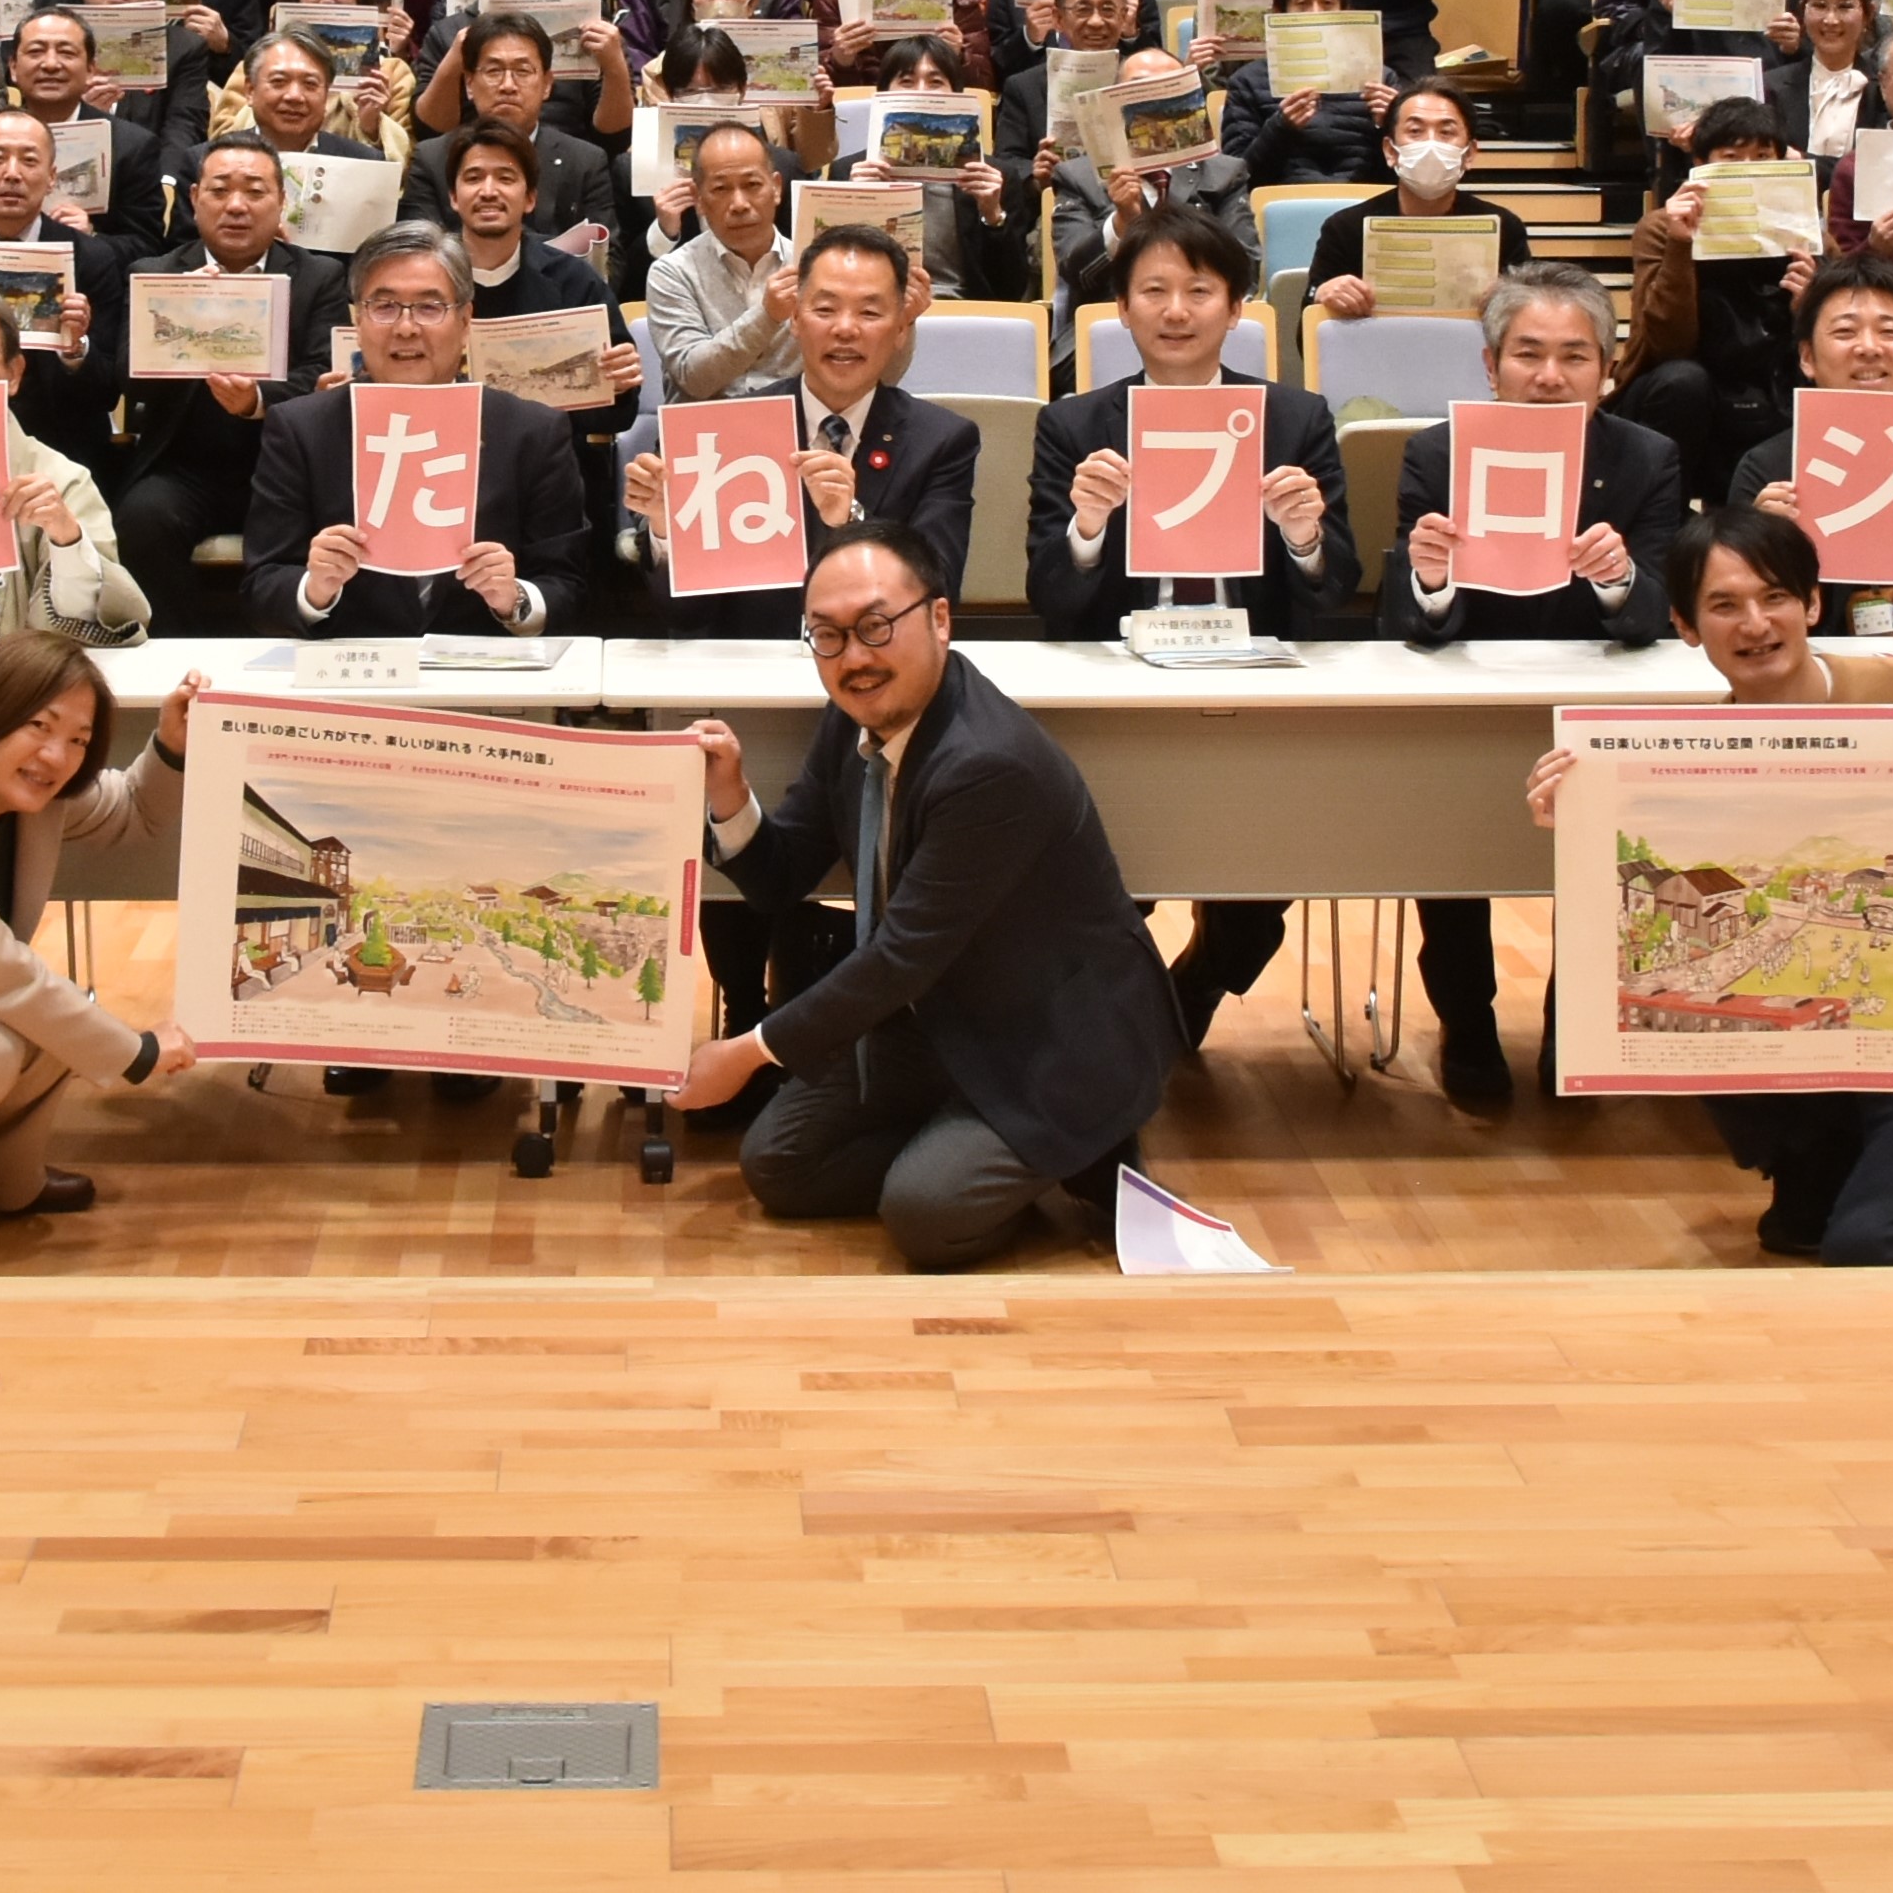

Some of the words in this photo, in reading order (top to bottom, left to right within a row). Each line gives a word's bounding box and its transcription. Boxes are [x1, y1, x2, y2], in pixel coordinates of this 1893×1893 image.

[366, 414, 466, 528] た
[673, 432, 796, 550] ね
[1142, 409, 1255, 530] プ
[1468, 447, 1564, 540] ロ
[335, 651, 380, 662] 小諸市長
[221, 719, 555, 766] 思い思いの過ごし方ができ、楽しいが溢れる「大手門公園」
[1590, 737, 1858, 751] 毎日楽しいおもてなし空間「小諸駅前広場」
